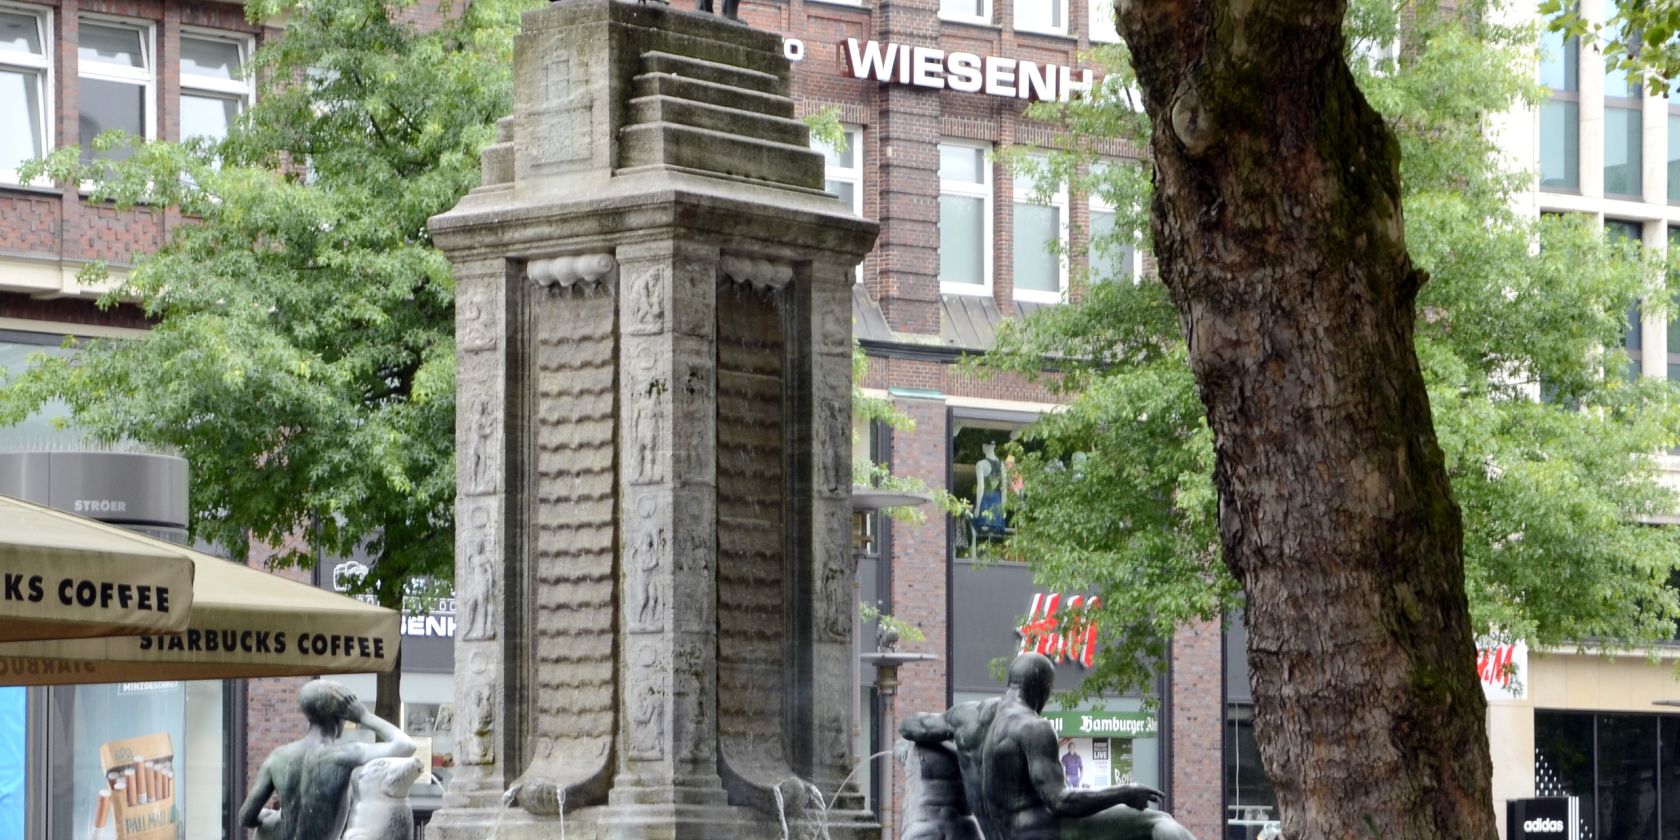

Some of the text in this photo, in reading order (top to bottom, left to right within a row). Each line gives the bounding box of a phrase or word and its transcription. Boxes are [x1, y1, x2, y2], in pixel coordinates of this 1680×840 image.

[74, 499, 126, 512] STRÖER
[58, 578, 169, 613] COFFEE
[297, 633, 385, 658] COFFEE
[1080, 715, 1144, 735] Hamburger
[1523, 817, 1564, 832] adidas
